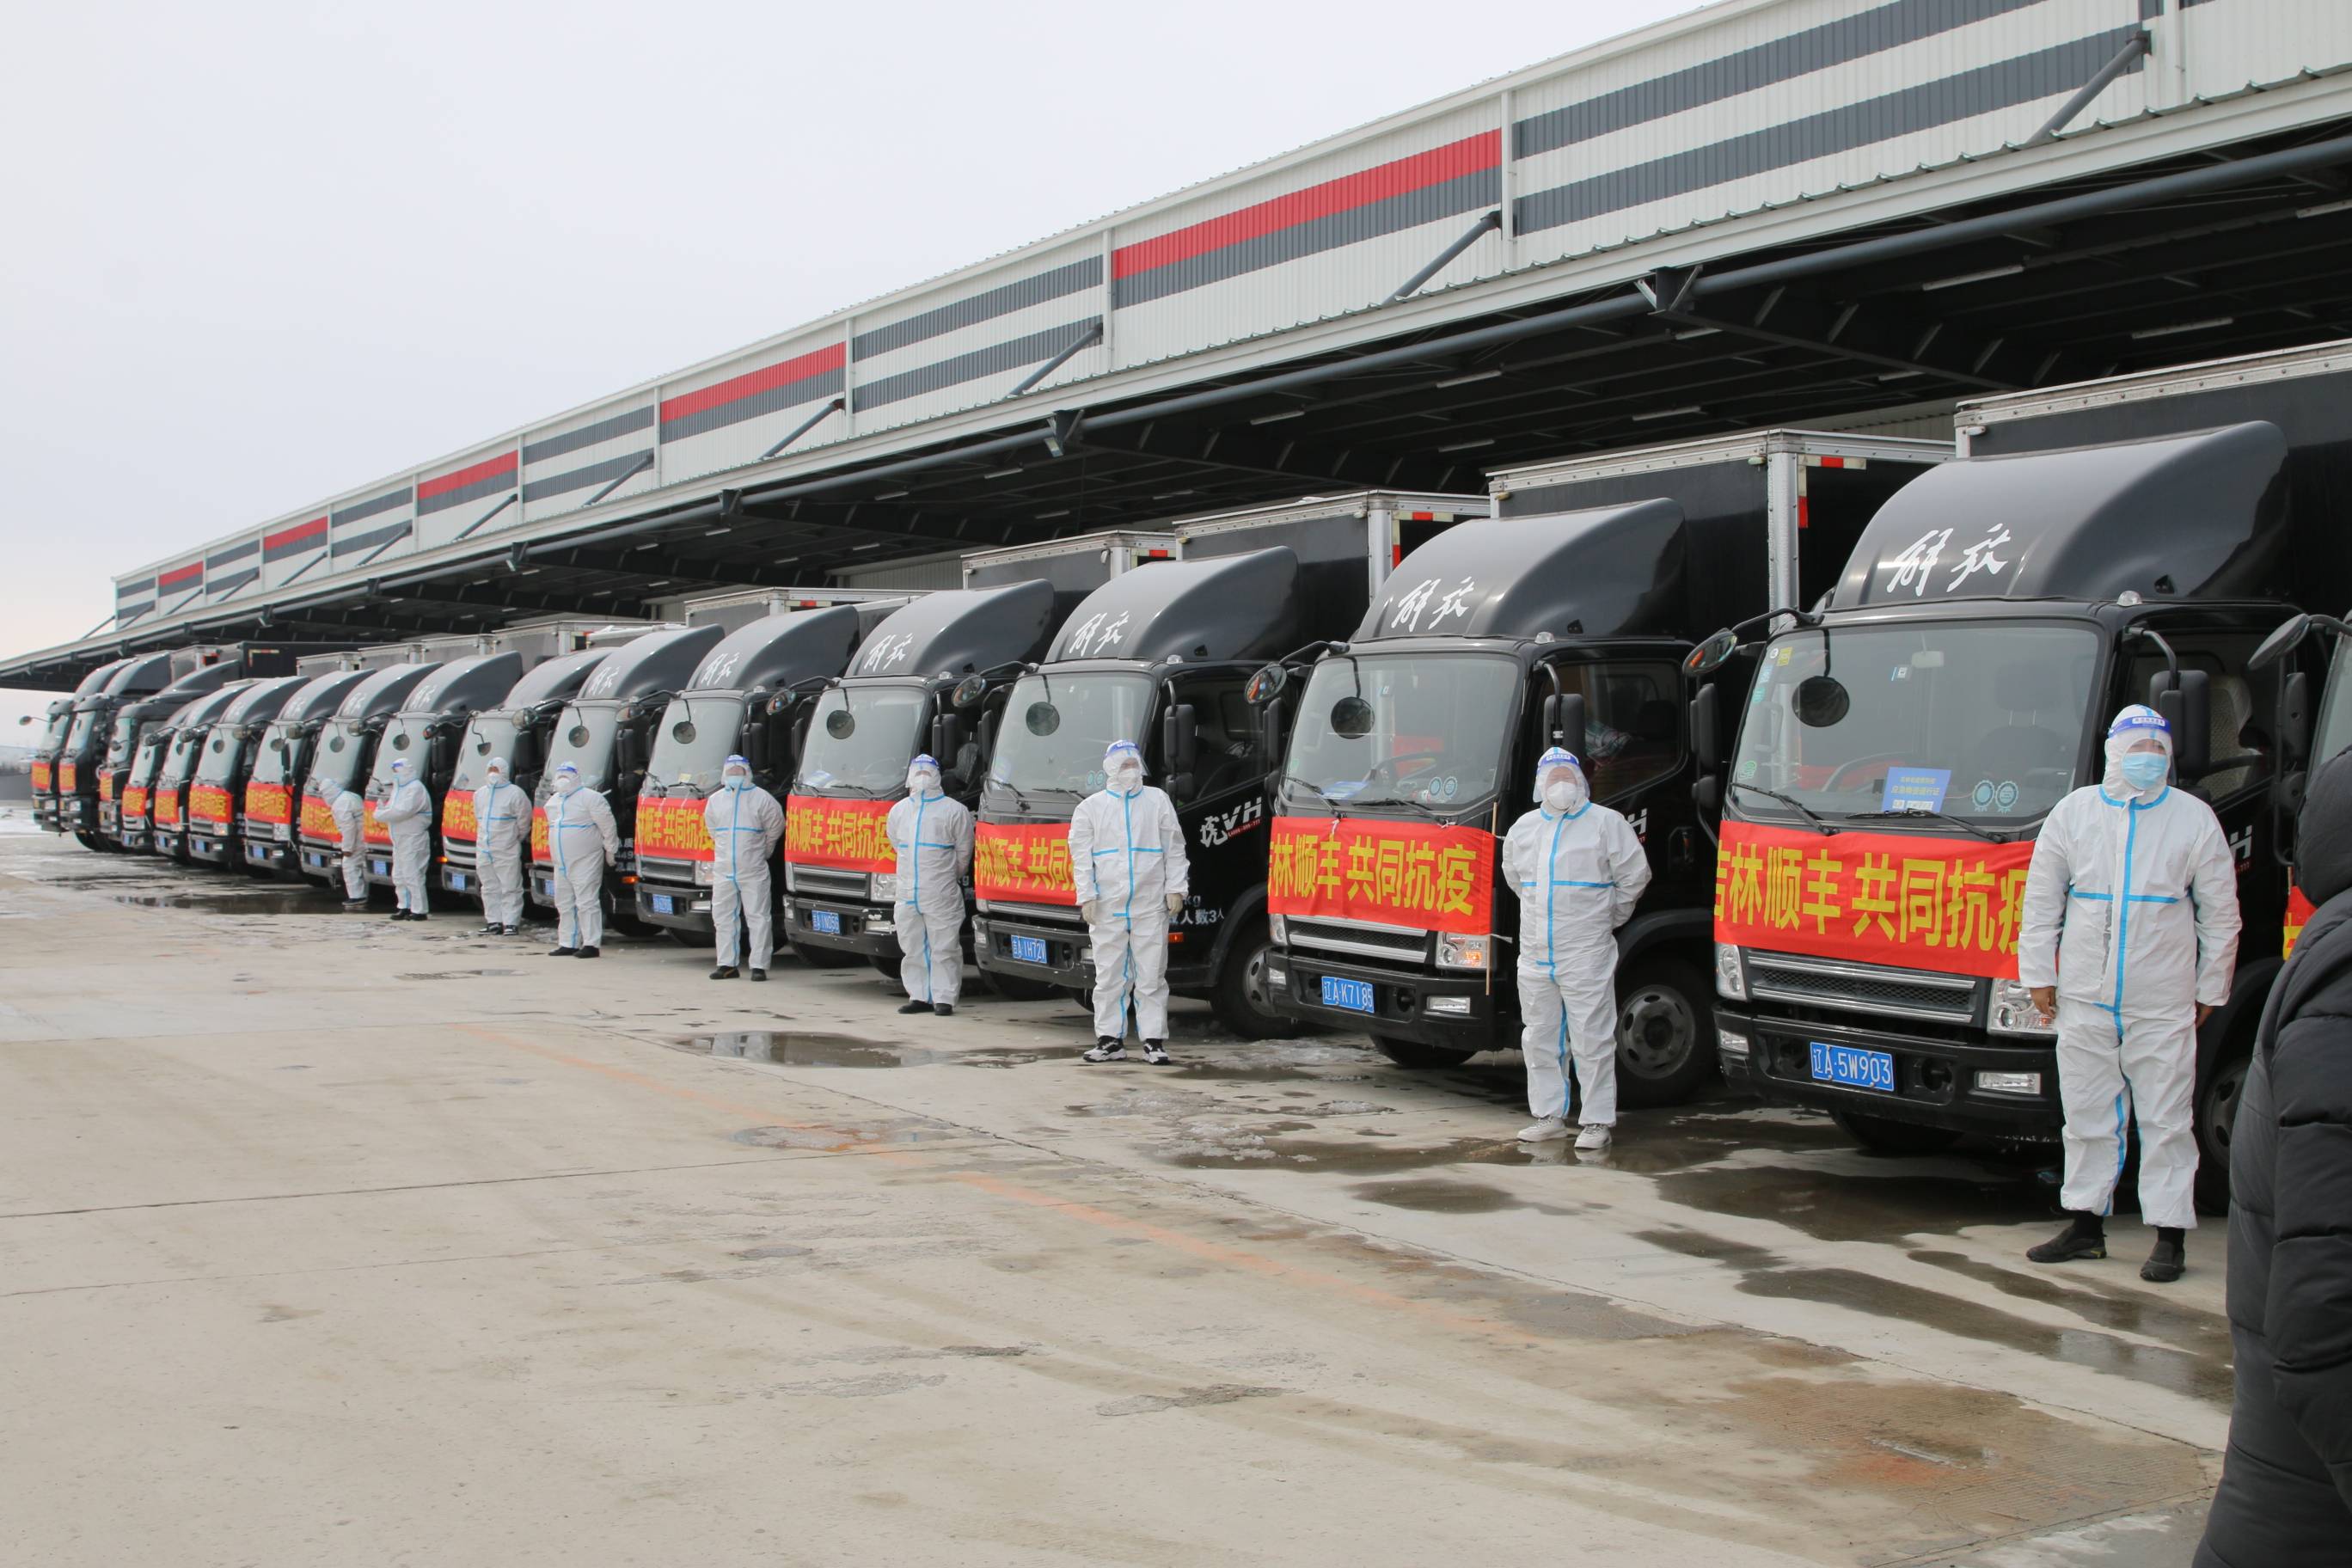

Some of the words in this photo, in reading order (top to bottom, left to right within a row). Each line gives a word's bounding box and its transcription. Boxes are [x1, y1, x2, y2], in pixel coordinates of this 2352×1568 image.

[1886, 523, 2012, 597] 解放
[1069, 609, 1130, 658] 解放
[1391, 576, 1475, 633] 解放
[1268, 832, 1342, 900] 林顺丰
